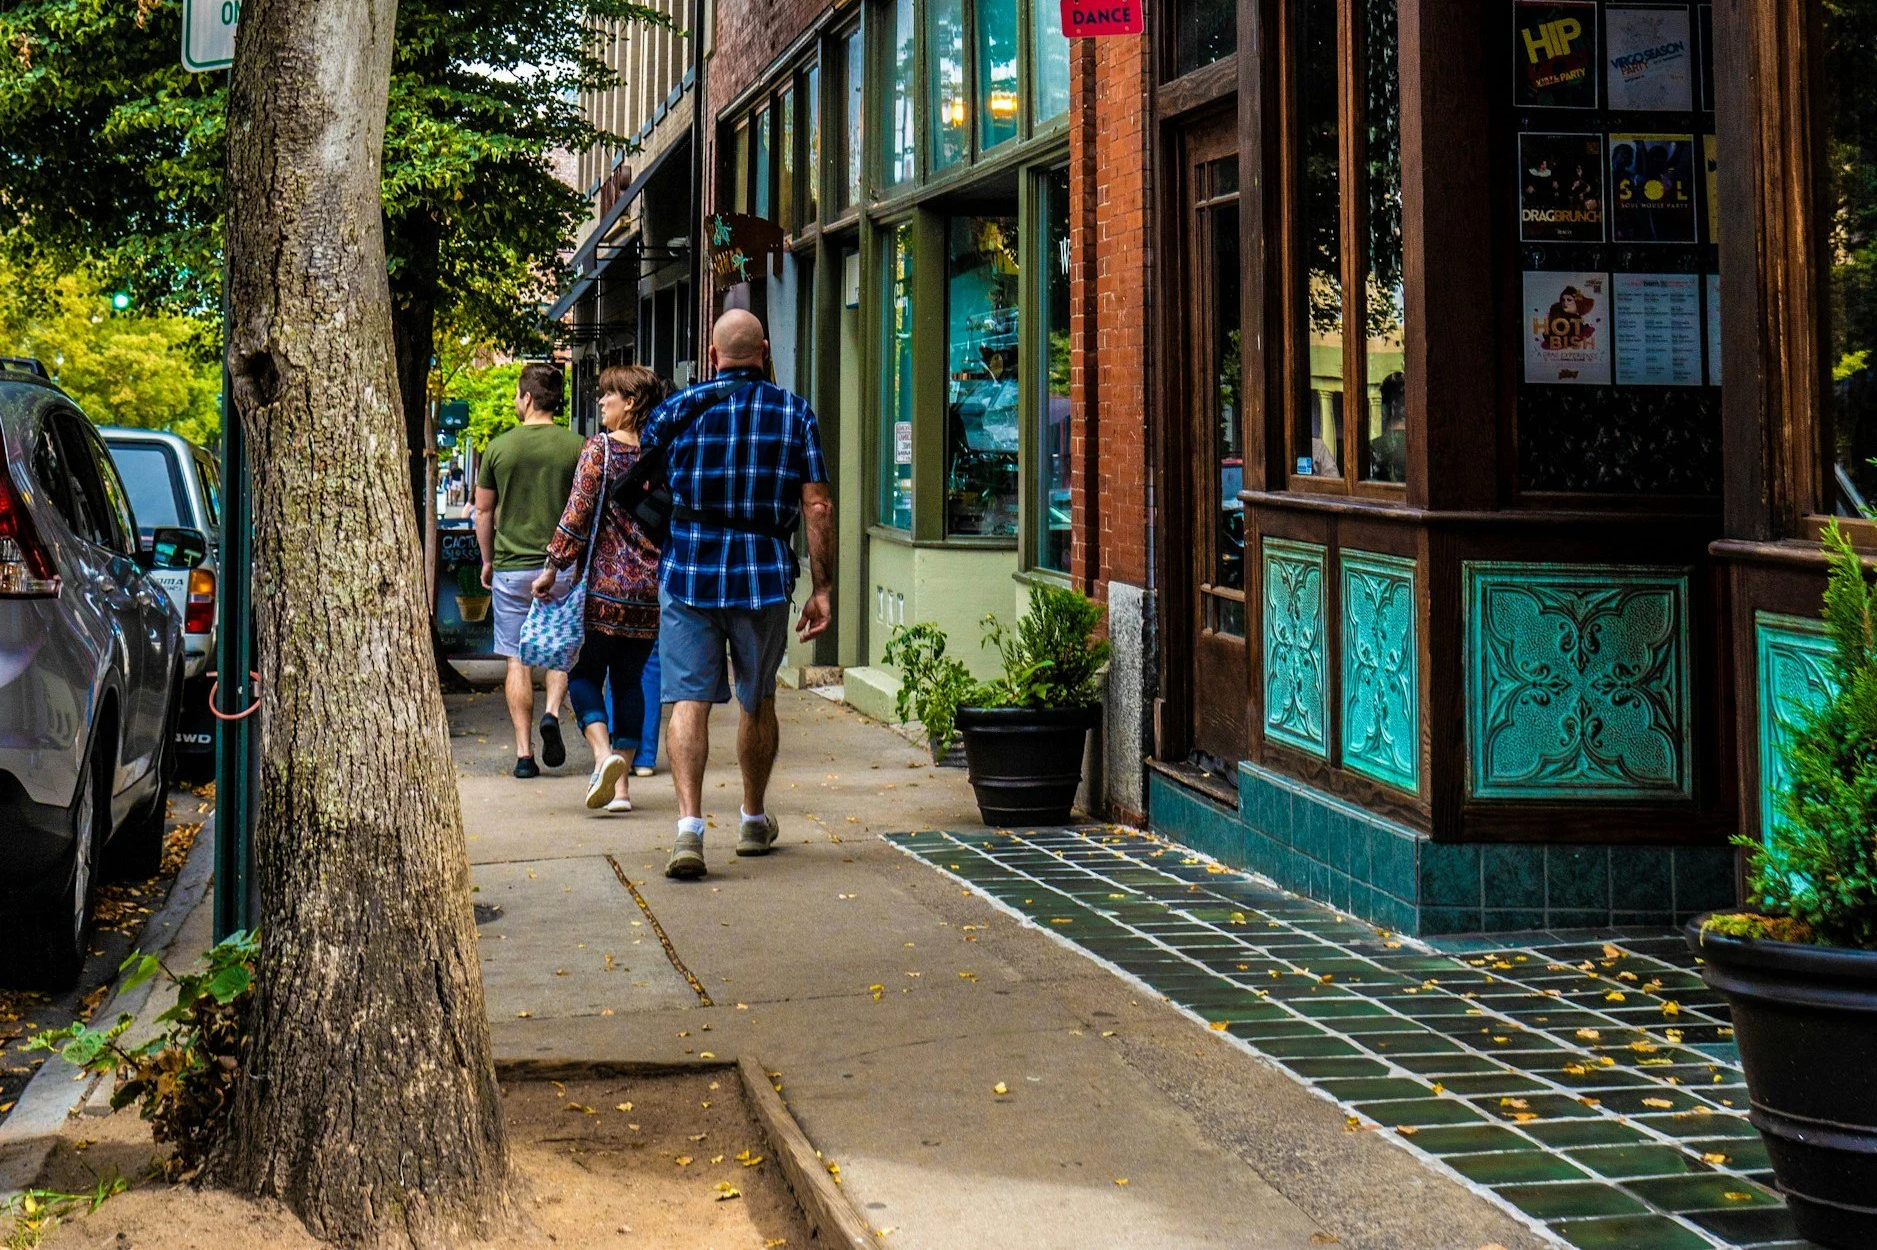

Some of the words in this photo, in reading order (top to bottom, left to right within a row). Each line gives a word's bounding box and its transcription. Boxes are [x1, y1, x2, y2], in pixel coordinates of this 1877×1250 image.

[1072, 8, 1131, 25] DANCE
[1521, 17, 1582, 64] HIP
[1611, 52, 1644, 69] VIRGO
[1644, 40, 1685, 61] SEASON
[1559, 67, 1586, 82] PARTY
[1620, 61, 1649, 76] PARTY
[1532, 317, 1584, 337] HOT
[1550, 335, 1596, 351] BISH
